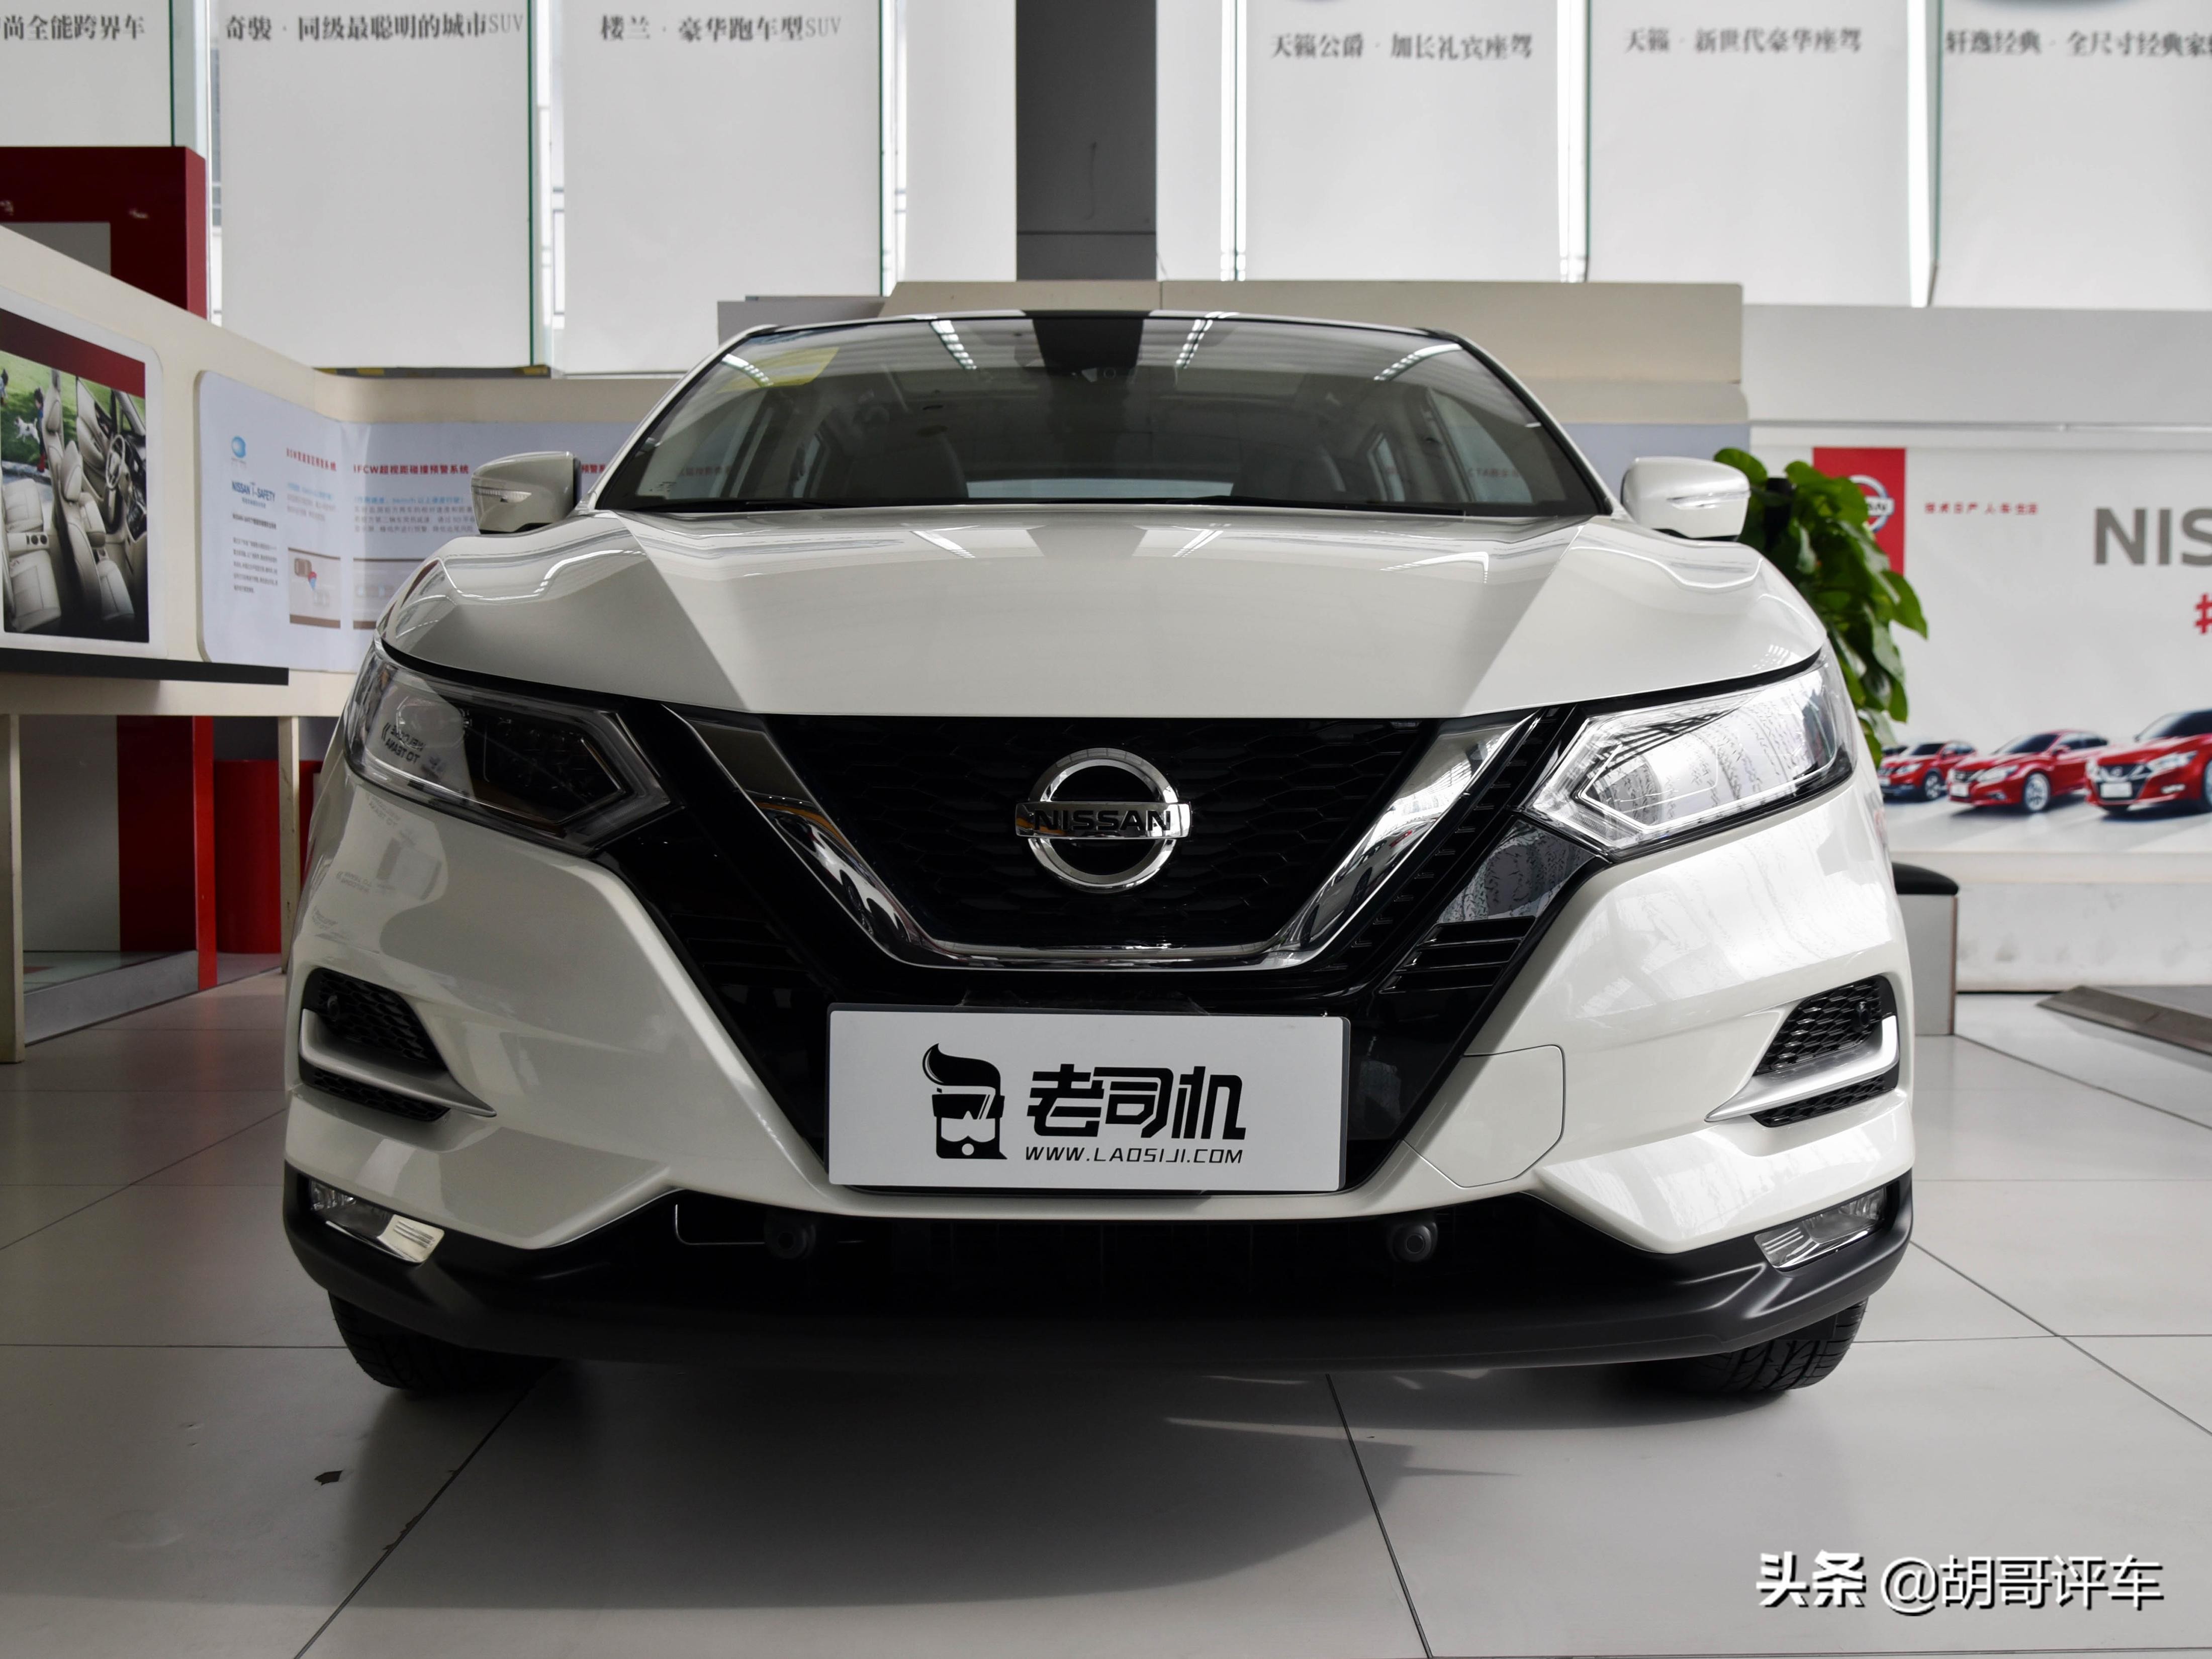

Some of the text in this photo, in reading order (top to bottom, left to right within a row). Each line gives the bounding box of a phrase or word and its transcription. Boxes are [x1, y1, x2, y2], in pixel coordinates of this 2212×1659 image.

[0, 14, 145, 41] 尚全能跨界车
[1945, 30, 2212, 58] 轩逸经典·全尺寸经典家
[1034, 809, 1171, 832] NISSAN
[1027, 1063, 1246, 1140] 老司机
[1026, 1146, 1243, 1164] WWW.LAOSIJI.COM
